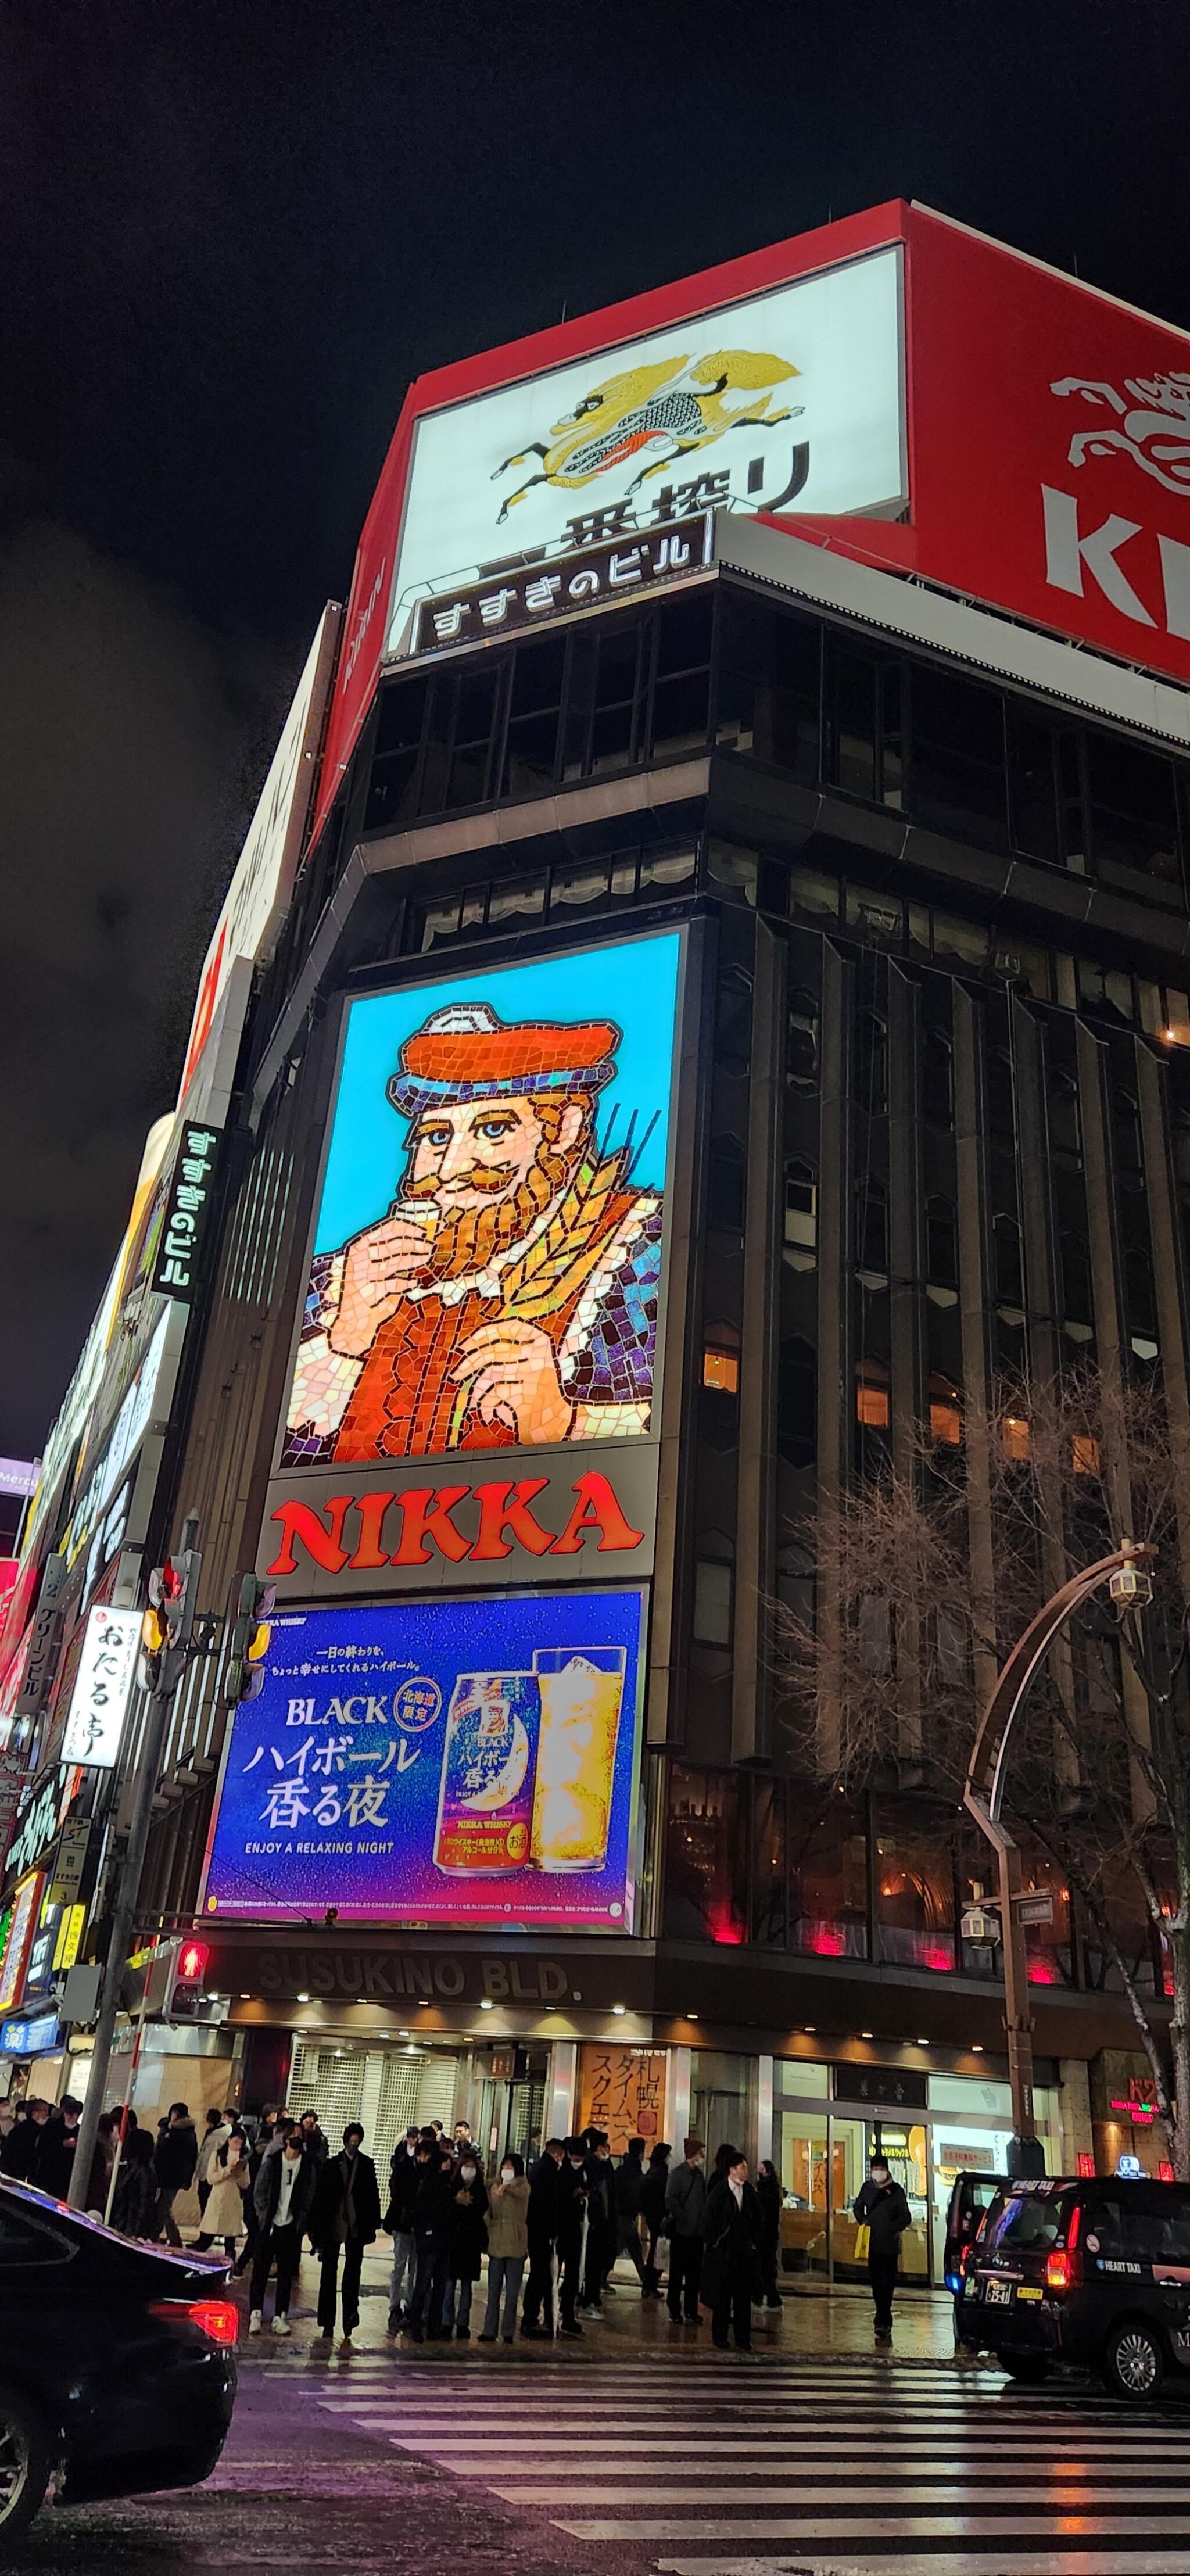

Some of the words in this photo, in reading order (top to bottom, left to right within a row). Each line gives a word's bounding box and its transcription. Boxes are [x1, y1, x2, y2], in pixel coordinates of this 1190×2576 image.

[432, 535, 690, 640] すすきのビル
[159, 1130, 217, 1288] すすきのビル
[266, 1470, 646, 1576] NIKKA
[271, 1661, 420, 1676] ちょっと幸せにしてくれるハイボール。
[316, 1646, 385, 1659] 一日の終わりを、
[285, 1696, 389, 1726] BLACK
[402, 1707, 428, 1722] 限定
[403, 1690, 436, 1707] 北海道
[242, 1735, 421, 1776] ハイボール
[258, 1775, 391, 1829] 香る夜
[245, 1843, 282, 1854] ENJOY
[285, 1843, 292, 1853] A
[296, 1843, 353, 1853] RELAXING
[357, 1843, 394, 1853] NIGHT
[258, 1953, 465, 1996] SUSUKINO
[482, 1959, 583, 2001] BLD.
[612, 2054, 636, 2143] タイムズ
[636, 2055, 660, 2109] 札幌
[1105, 2260, 1126, 2272] HEART
[1126, 2262, 1141, 2274] TAXI
